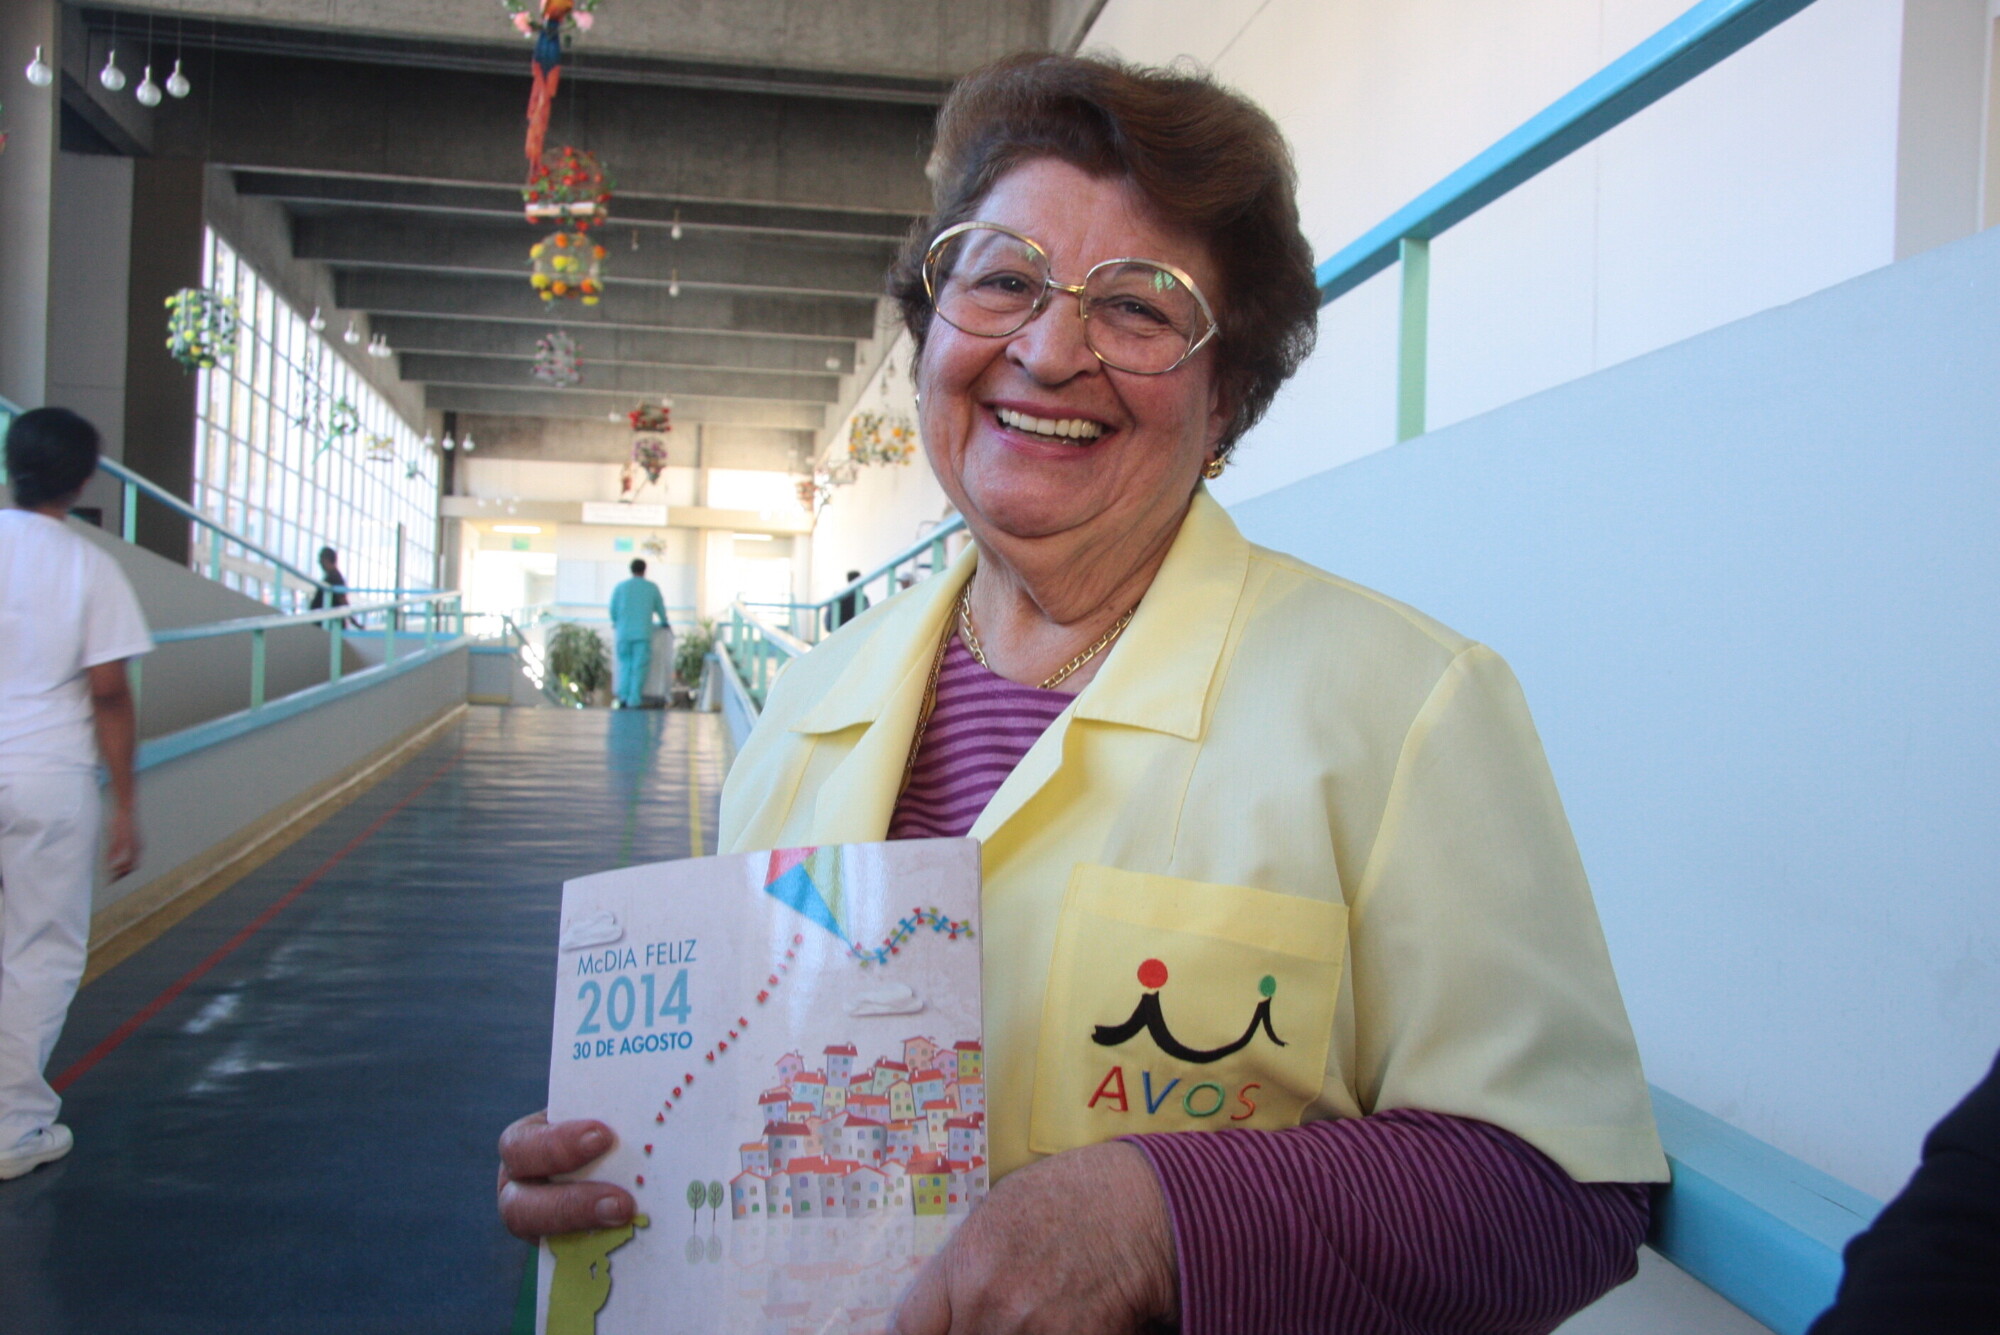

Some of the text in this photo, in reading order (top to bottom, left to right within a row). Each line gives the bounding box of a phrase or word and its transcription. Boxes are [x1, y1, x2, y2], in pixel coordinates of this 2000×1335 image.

[577, 939, 697, 976] McDIA FELIZ
[576, 968, 692, 1036] 2014
[573, 1031, 693, 1060] 30 DE AGOSTO
[706, 1016, 749, 1062] VALE
[1088, 1066, 1261, 1120] AVOS
